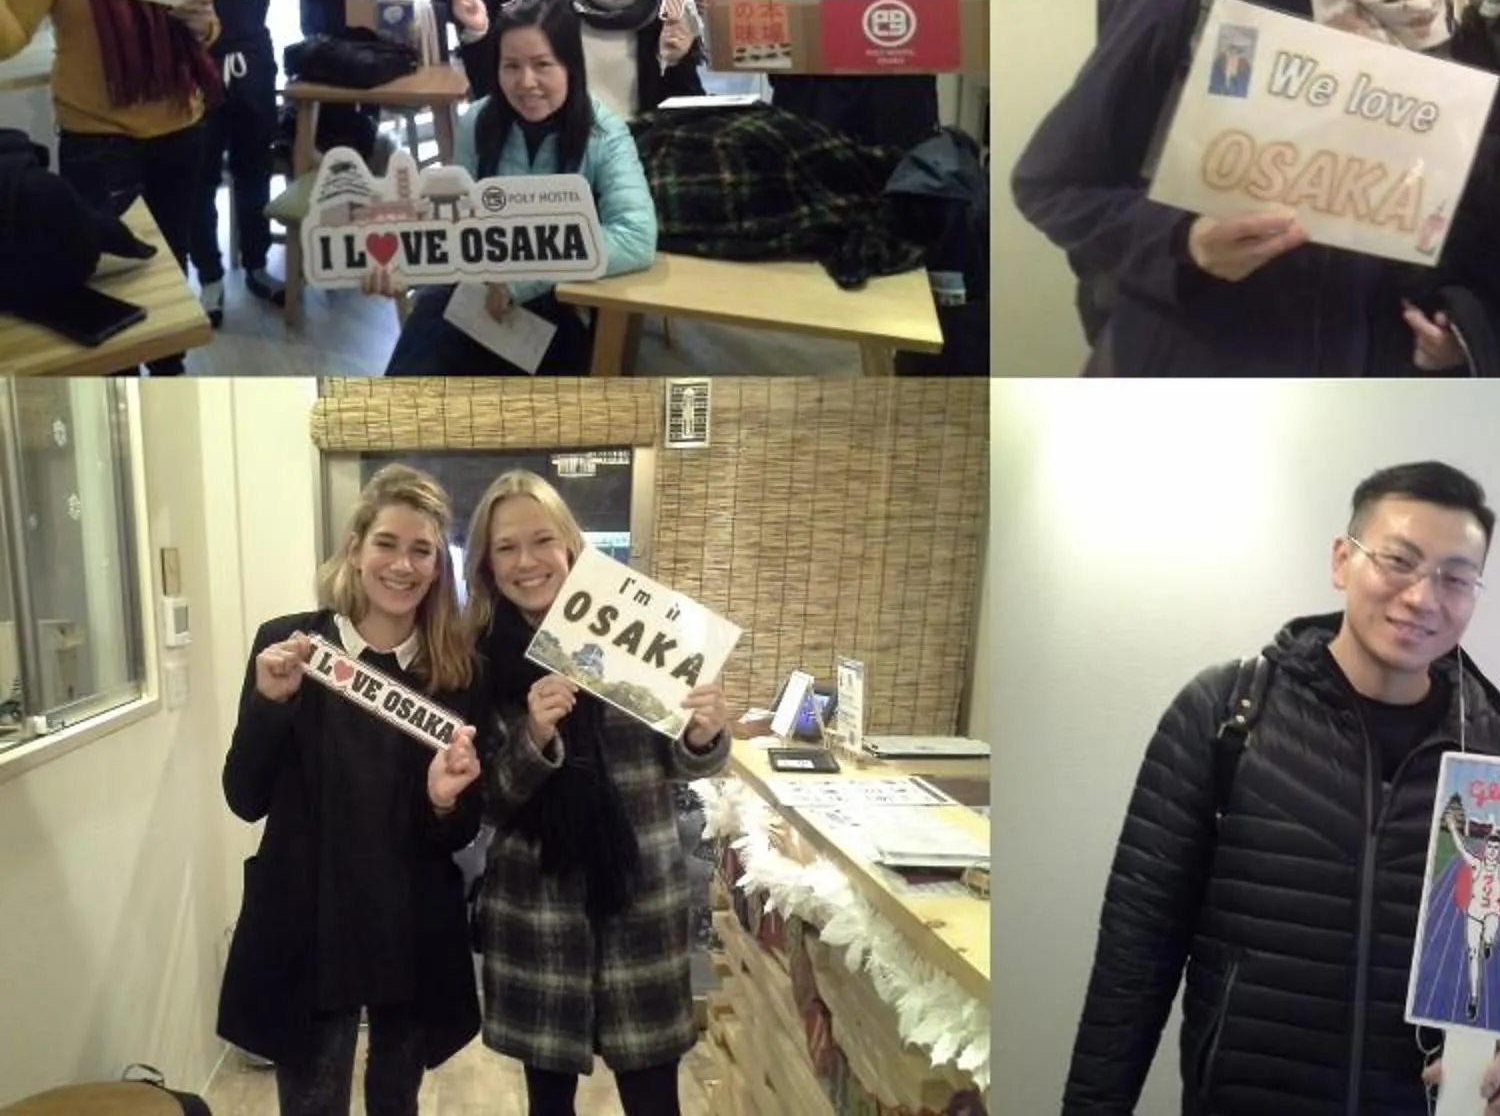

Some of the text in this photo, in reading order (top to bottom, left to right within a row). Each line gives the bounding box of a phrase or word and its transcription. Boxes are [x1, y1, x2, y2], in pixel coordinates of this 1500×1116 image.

[1268, 51, 1440, 133] We love
[508, 191, 582, 205] POLY HOSTEL
[1202, 129, 1425, 233] OSAKA
[320, 236, 334, 270] I
[460, 224, 589, 264] OSAKA
[563, 590, 705, 688] OSAKA
[382, 689, 456, 744] OSAKA
